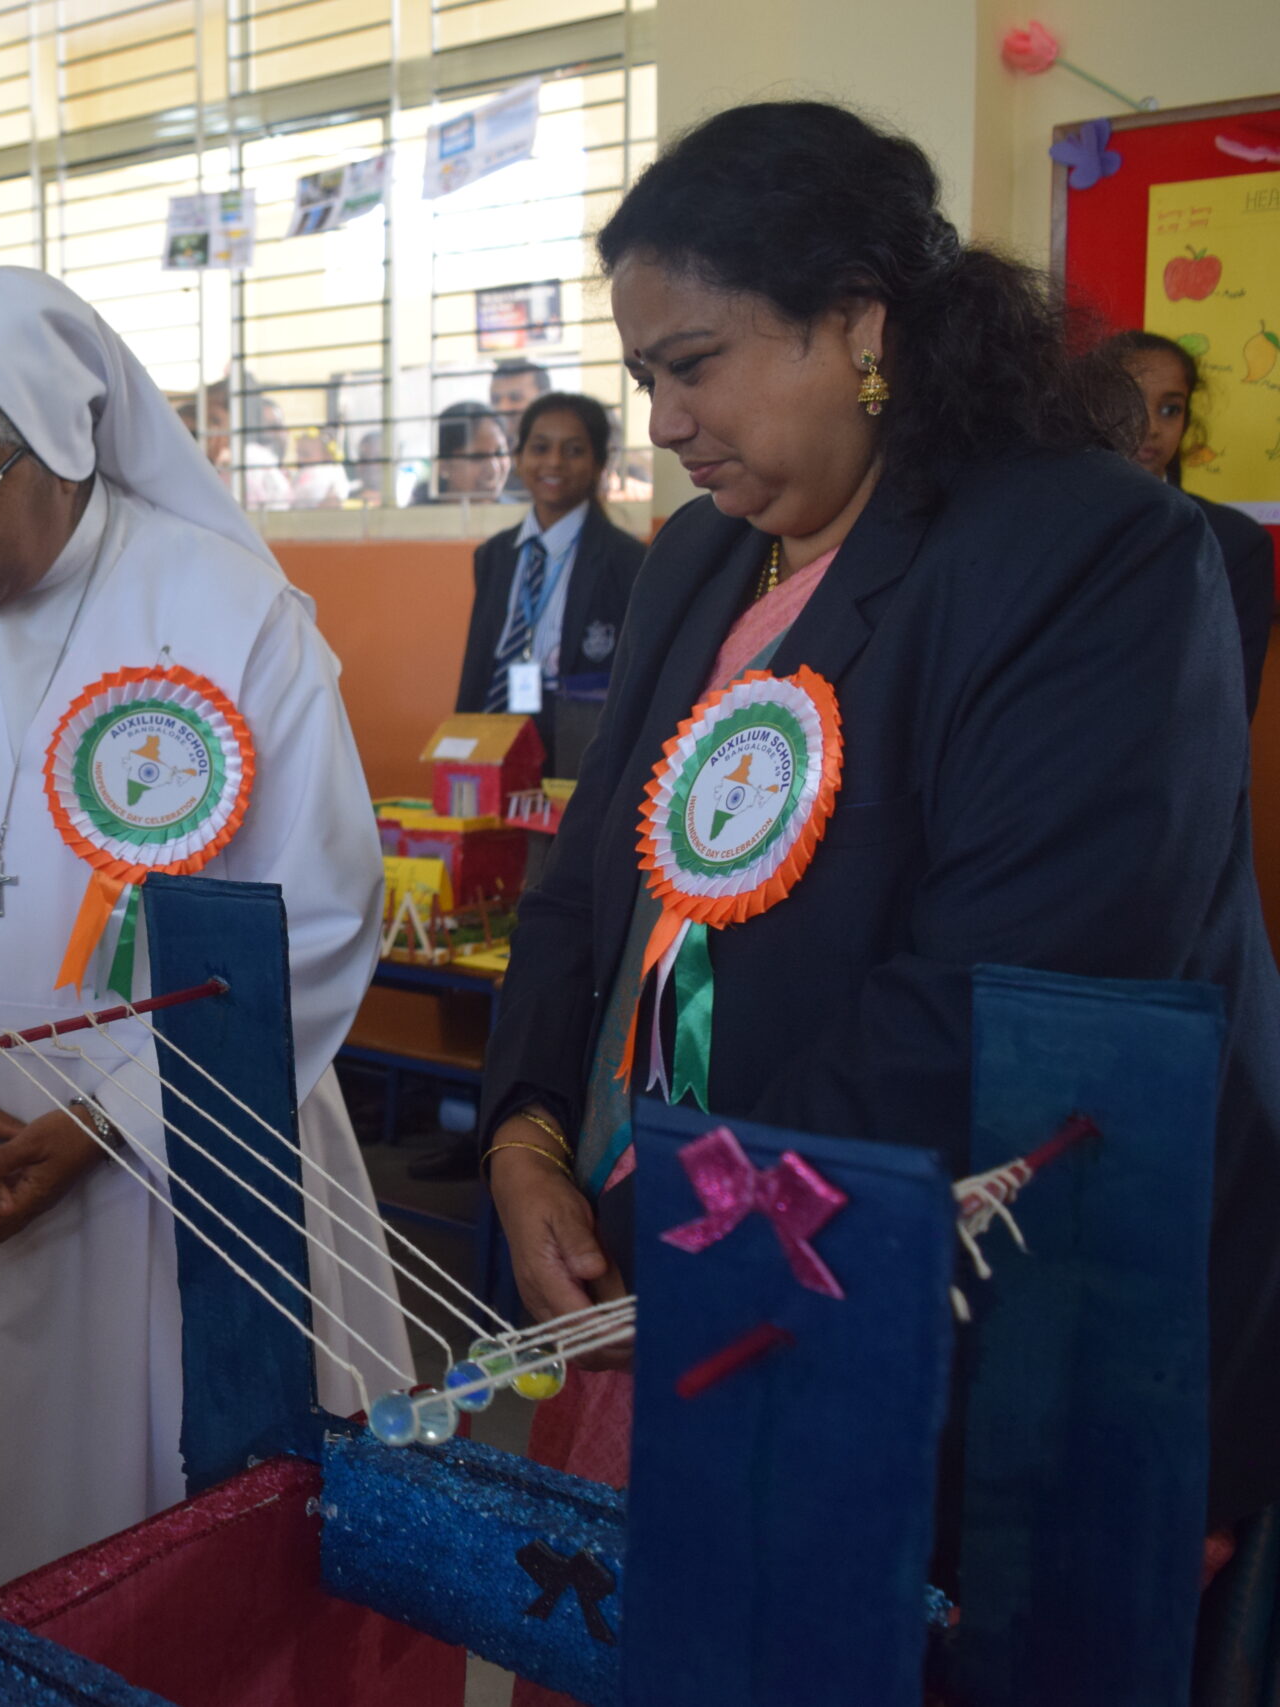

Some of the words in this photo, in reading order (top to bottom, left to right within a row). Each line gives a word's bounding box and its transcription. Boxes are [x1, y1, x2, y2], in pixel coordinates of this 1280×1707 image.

[110, 715, 176, 739] AUXILIUM
[178, 725, 208, 777] SCHOOL
[127, 726, 187, 746] BANGALORE
[710, 730, 771, 767] AUXILIUM
[770, 735, 791, 792] SCHOOL
[724, 743, 776, 761] BANGALORE
[95, 761, 128, 817] INDEPENDENCE
[126, 813, 143, 824] DAY
[144, 796, 197, 824] CELEBRATION
[687, 795, 706, 854] INDEPENDENCE
[705, 848, 721, 859] DAY
[720, 817, 774, 859] CELEBRATION
